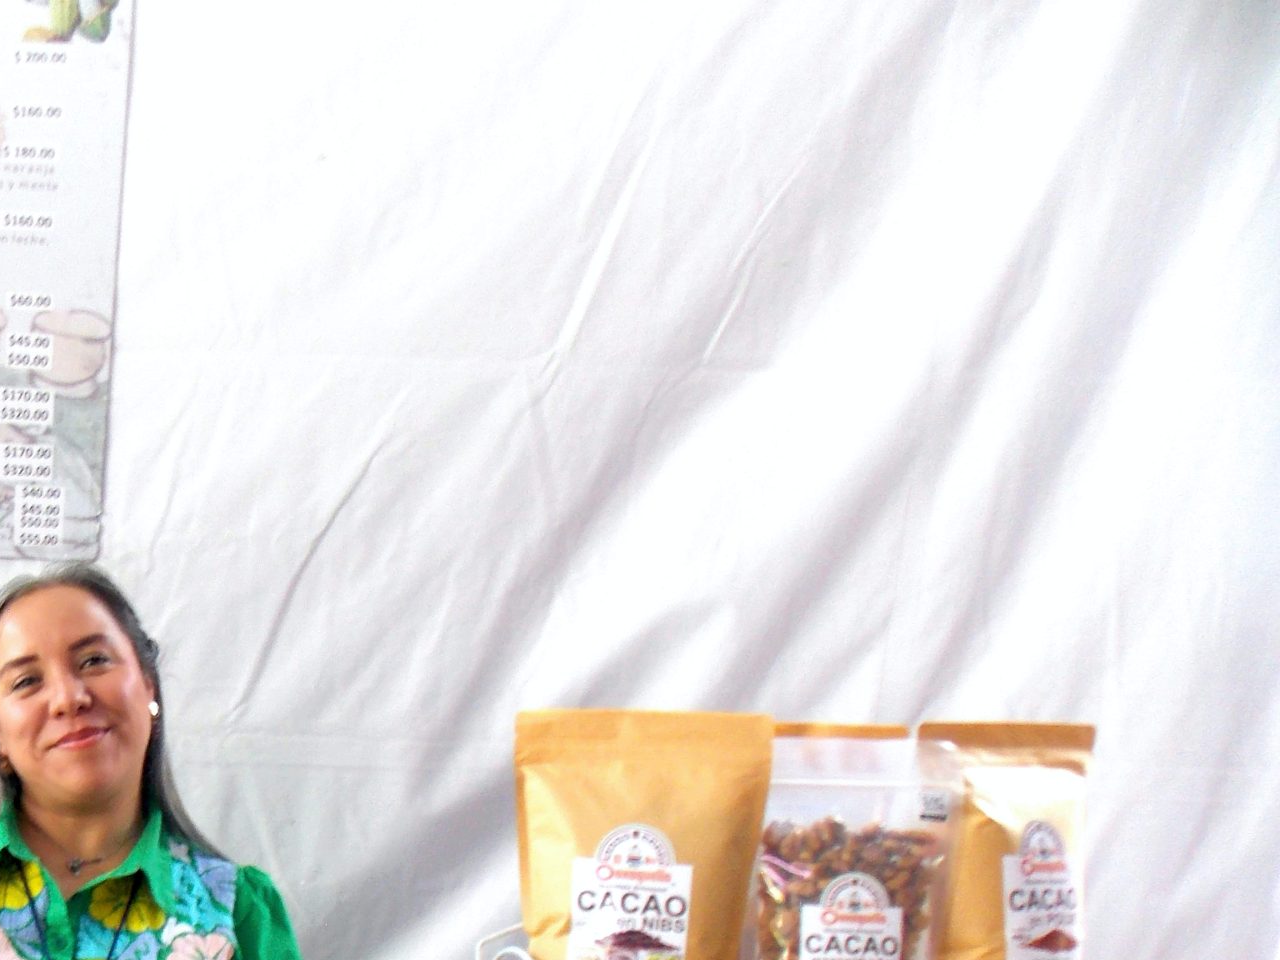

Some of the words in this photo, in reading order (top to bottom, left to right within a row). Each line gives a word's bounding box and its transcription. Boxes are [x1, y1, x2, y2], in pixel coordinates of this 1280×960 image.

[577, 890, 687, 918] CACAO
[642, 917, 686, 933] NIBS
[805, 934, 899, 956] CACAO
